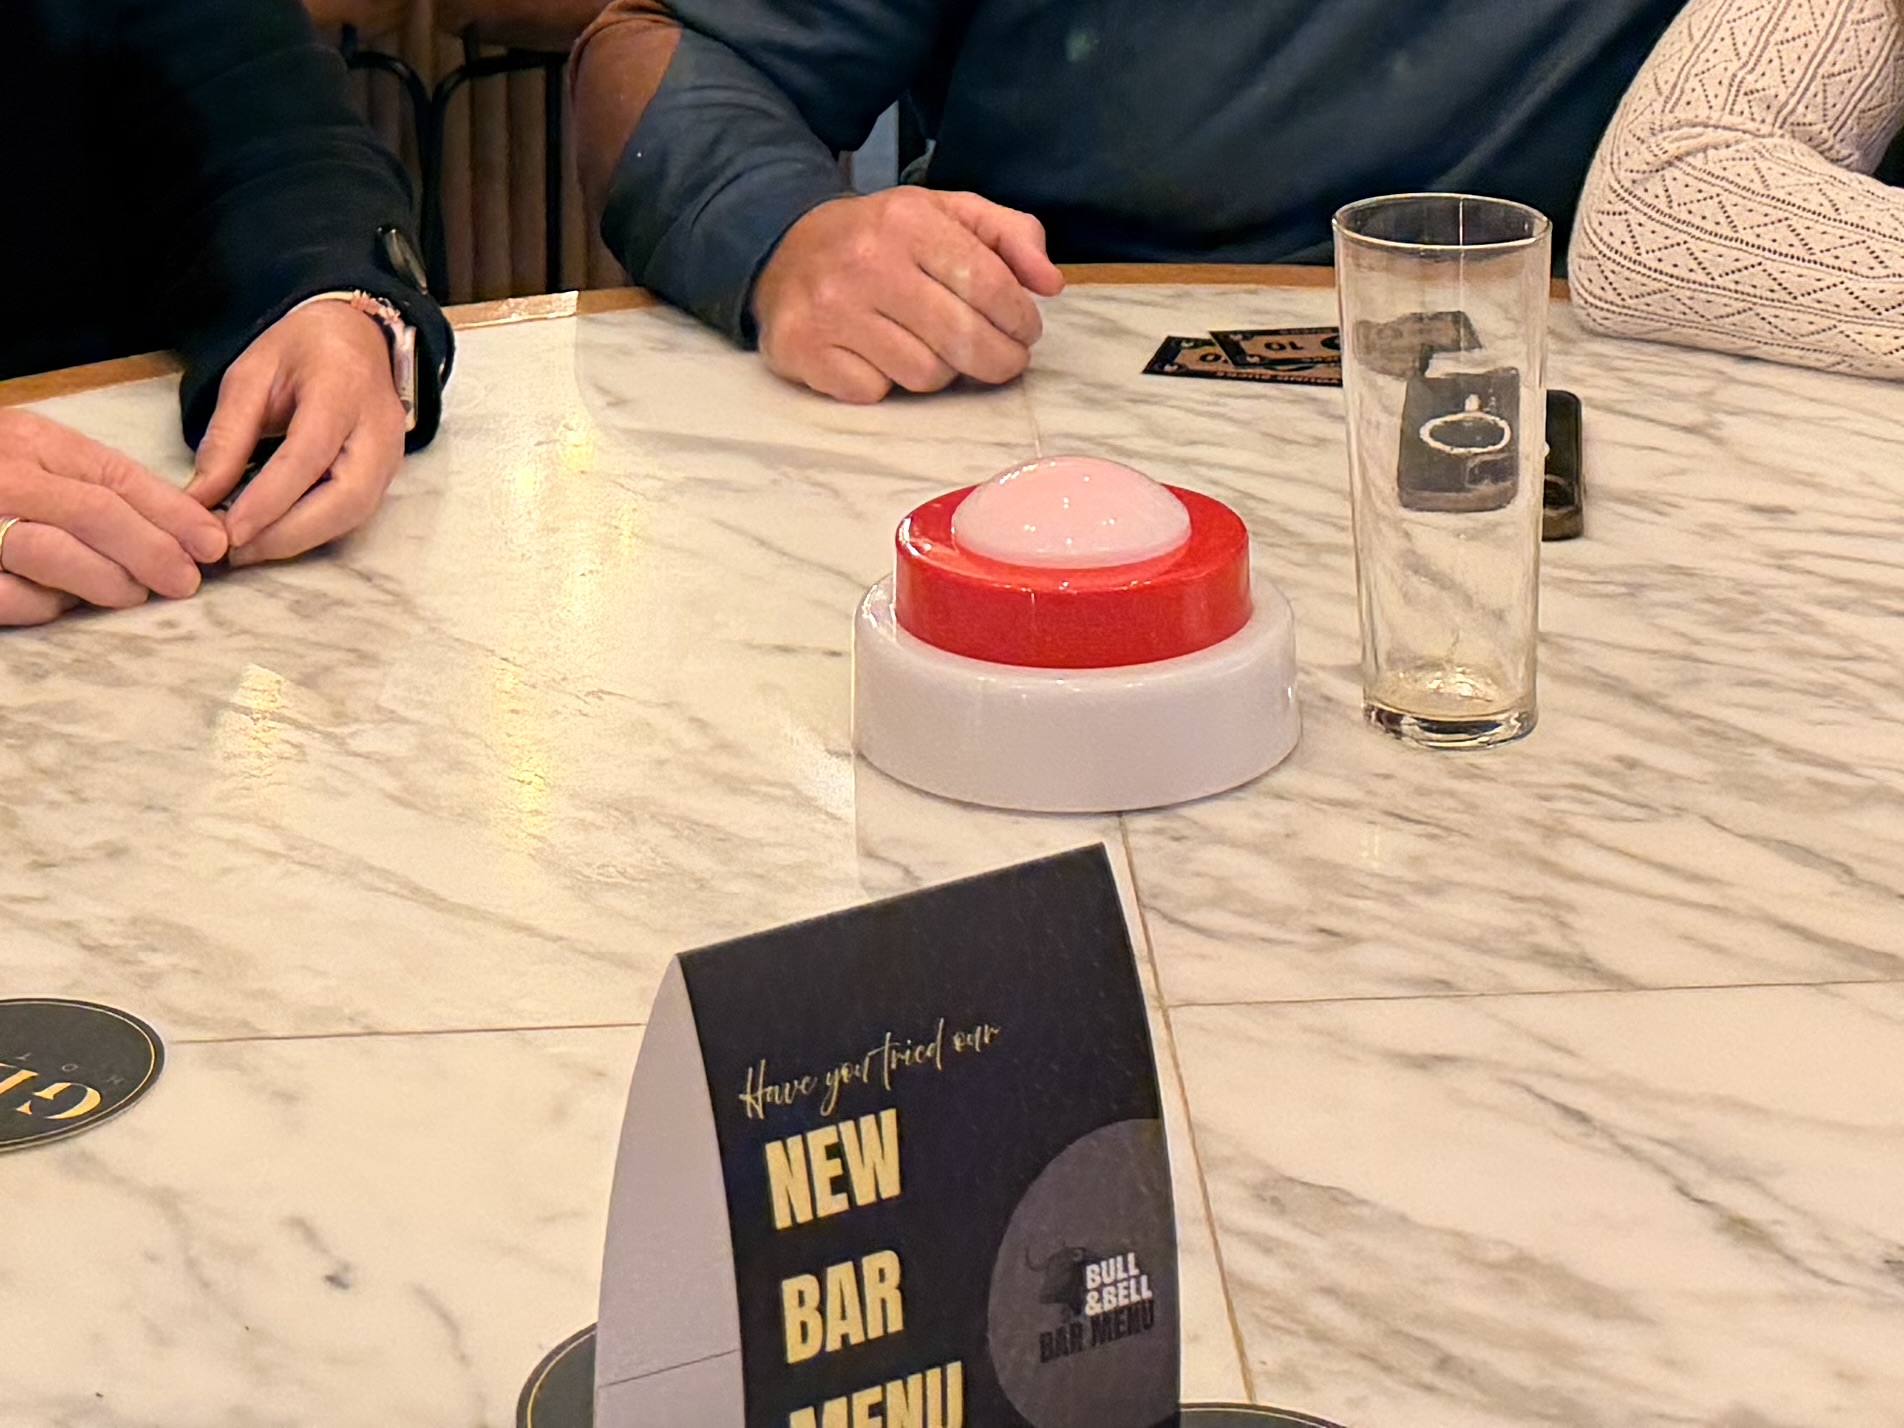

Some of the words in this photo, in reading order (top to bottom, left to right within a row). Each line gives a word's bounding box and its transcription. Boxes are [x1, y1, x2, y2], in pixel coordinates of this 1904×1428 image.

[738, 1058, 818, 1120] Have
[868, 1017, 945, 1091] tried
[764, 1107, 902, 1230] NEW
[1085, 1251, 1140, 1291] BULL
[1085, 1274, 1153, 1317] &BELL
[781, 1249, 904, 1365] BAR
[1039, 1321, 1084, 1364] BAR
[1089, 1298, 1155, 1348] MENU
[789, 1360, 963, 1428] NU
